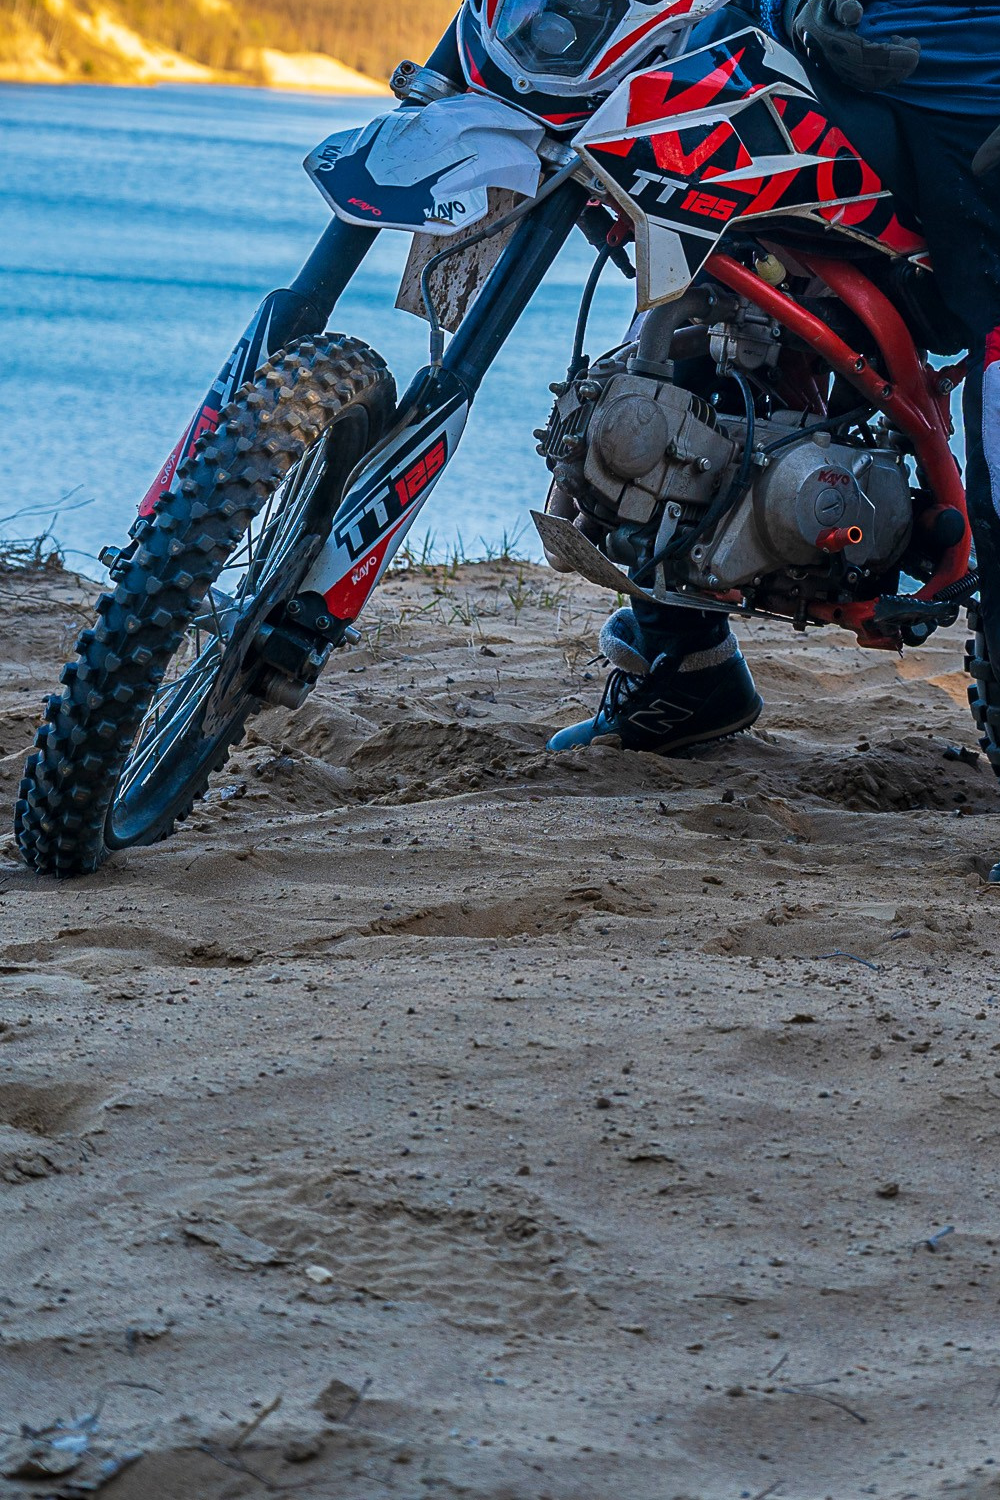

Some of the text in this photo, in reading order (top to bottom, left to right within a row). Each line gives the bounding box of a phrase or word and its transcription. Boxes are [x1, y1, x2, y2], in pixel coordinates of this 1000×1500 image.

[628, 169, 738, 222] TT 125
[340, 440, 445, 552] TT 125
